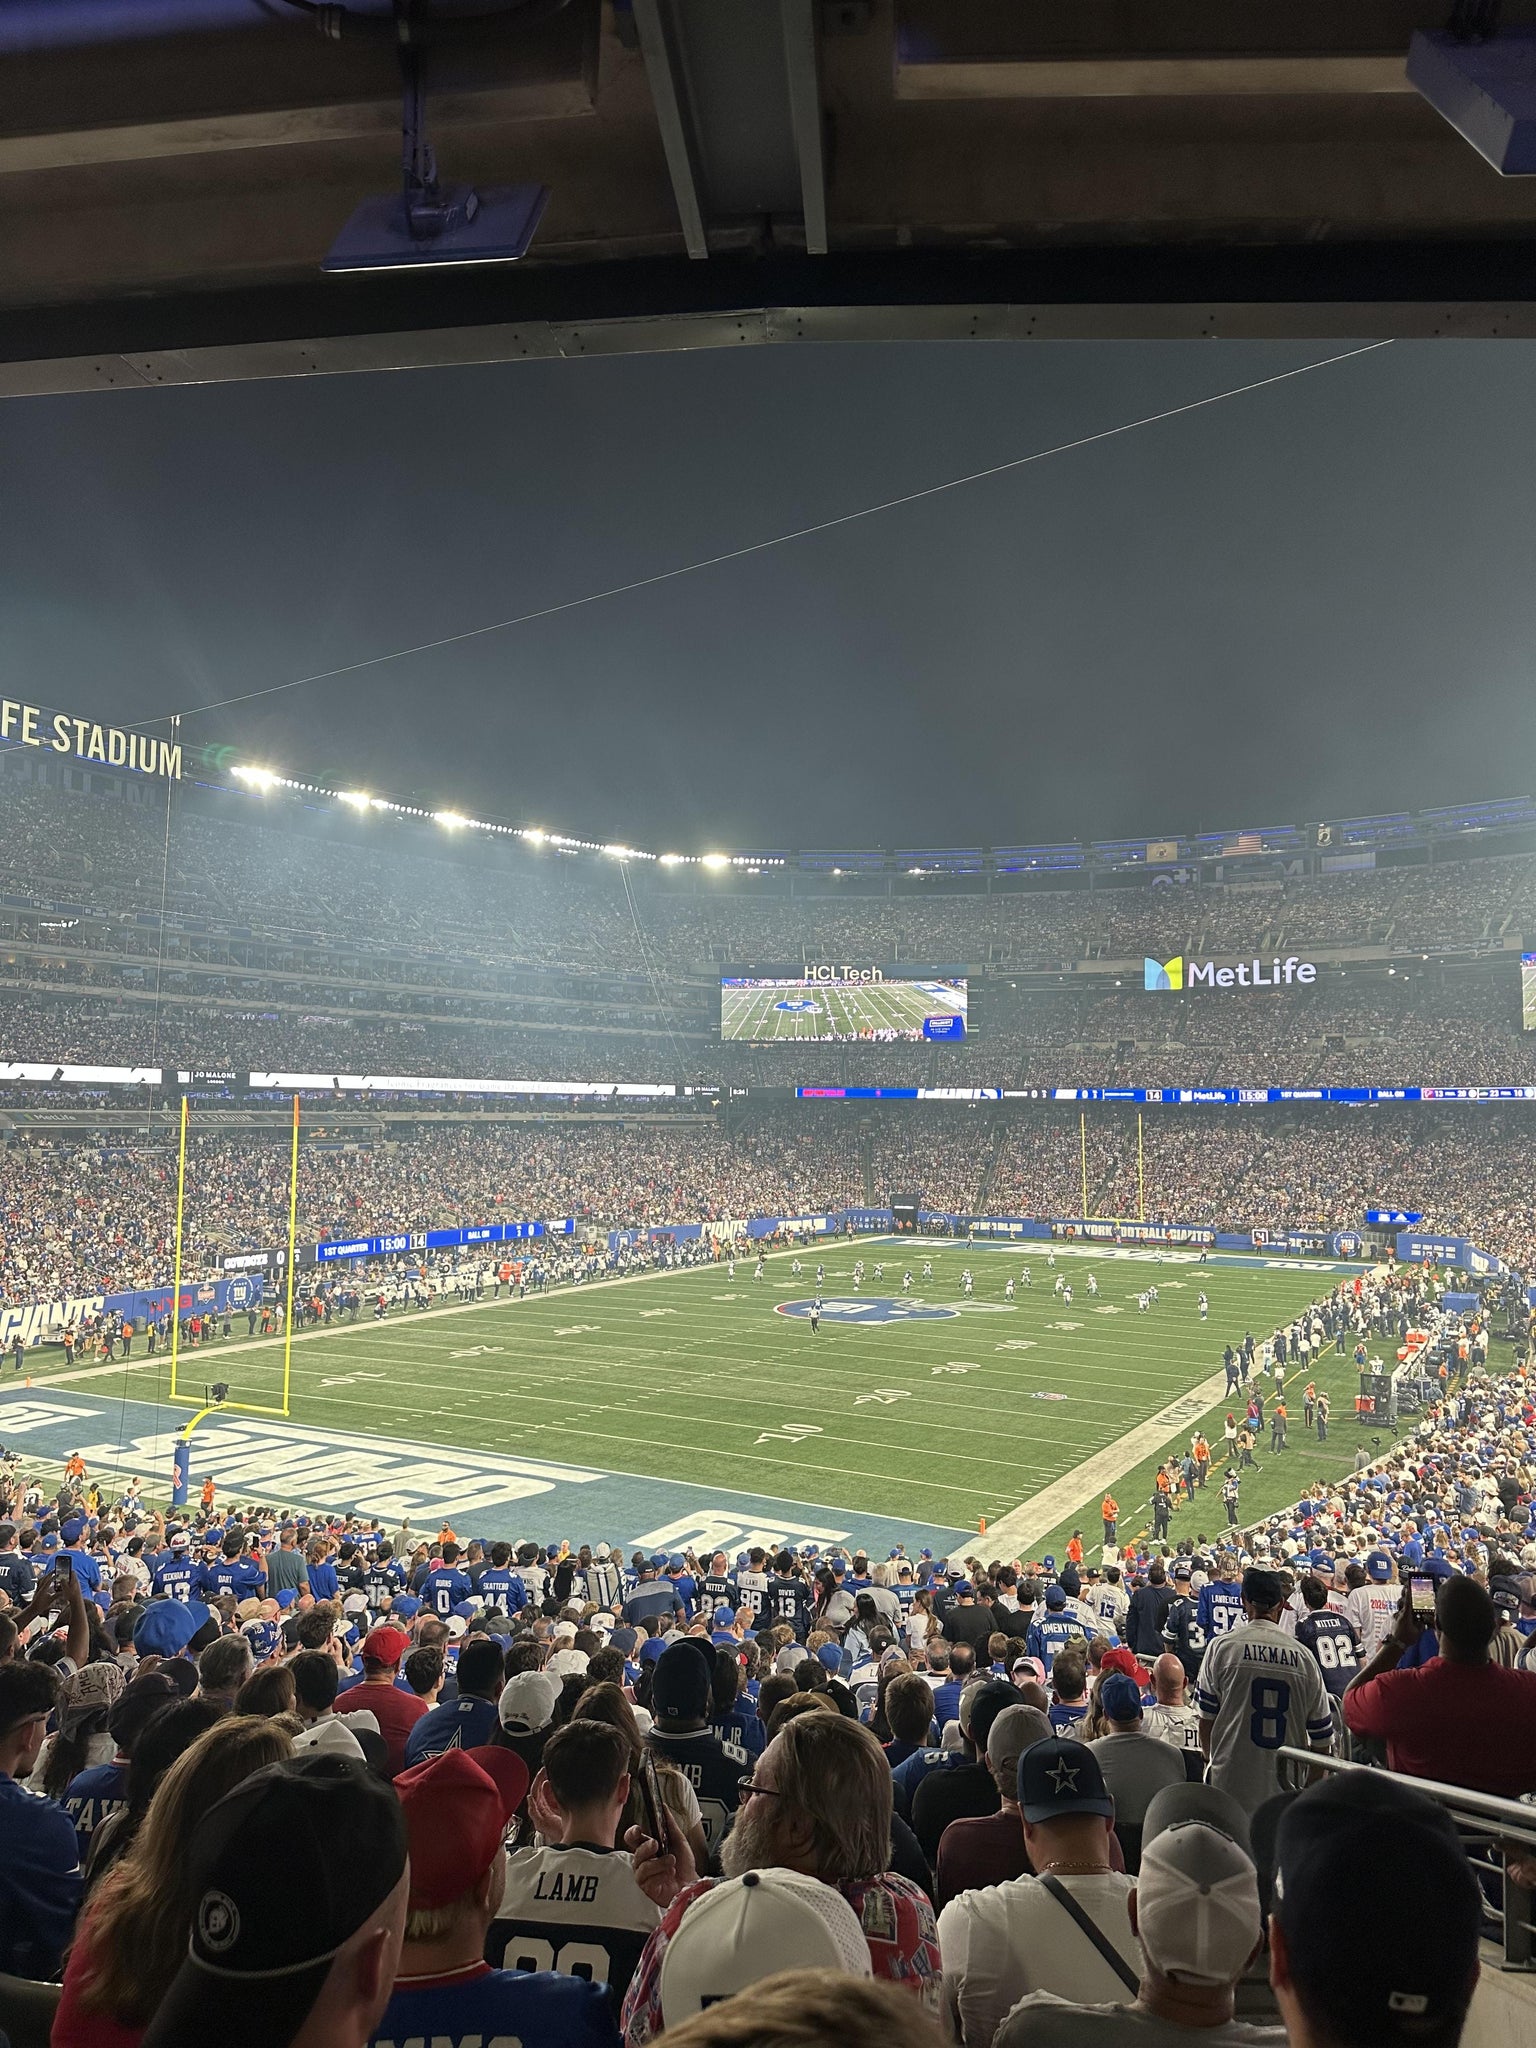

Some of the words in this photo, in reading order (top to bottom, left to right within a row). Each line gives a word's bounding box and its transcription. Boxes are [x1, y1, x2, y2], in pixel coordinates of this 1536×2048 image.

[1, 700, 41, 746] FE
[52, 714, 182, 779] STADIUM
[804, 965, 883, 981] HCLTech
[1188, 956, 1317, 987] MetLife
[206, 1071, 237, 1079] MALONE
[1148, 1091, 1161, 1100] 14
[1194, 1092, 1226, 1100] MetLife
[1242, 1090, 1267, 1100] 15:00
[323, 1246, 336, 1257] 1ST
[337, 1243, 369, 1255] QUARTER
[379, 1238, 407, 1251] 15:00
[412, 1237, 426, 1248] 14
[276, 1249, 285, 1265] 0
[0, 1296, 104, 1347] GIANTS
[855, 1388, 913, 1405] 20
[758, 1423, 824, 1444] 10
[62, 1428, 556, 1521] GIANTS
[218, 1574, 233, 1583] DART
[705, 1582, 727, 1593] WITTEN
[437, 1589, 450, 1614] 0
[779, 1597, 796, 1618] 13
[1211, 1594, 1239, 1606] LAWRENCE
[1099, 1601, 1115, 1619] 13
[1213, 1605, 1244, 1635] 97
[1315, 1618, 1341, 1628] WITTEN
[1041, 1623, 1084, 1635] UMENYIORA
[1187, 1621, 1206, 1649] 3
[1243, 1643, 1299, 1668] AIKMAN
[1316, 1634, 1357, 1669] 82
[1250, 1676, 1291, 1750] 8
[533, 1871, 599, 1904] LAMB
